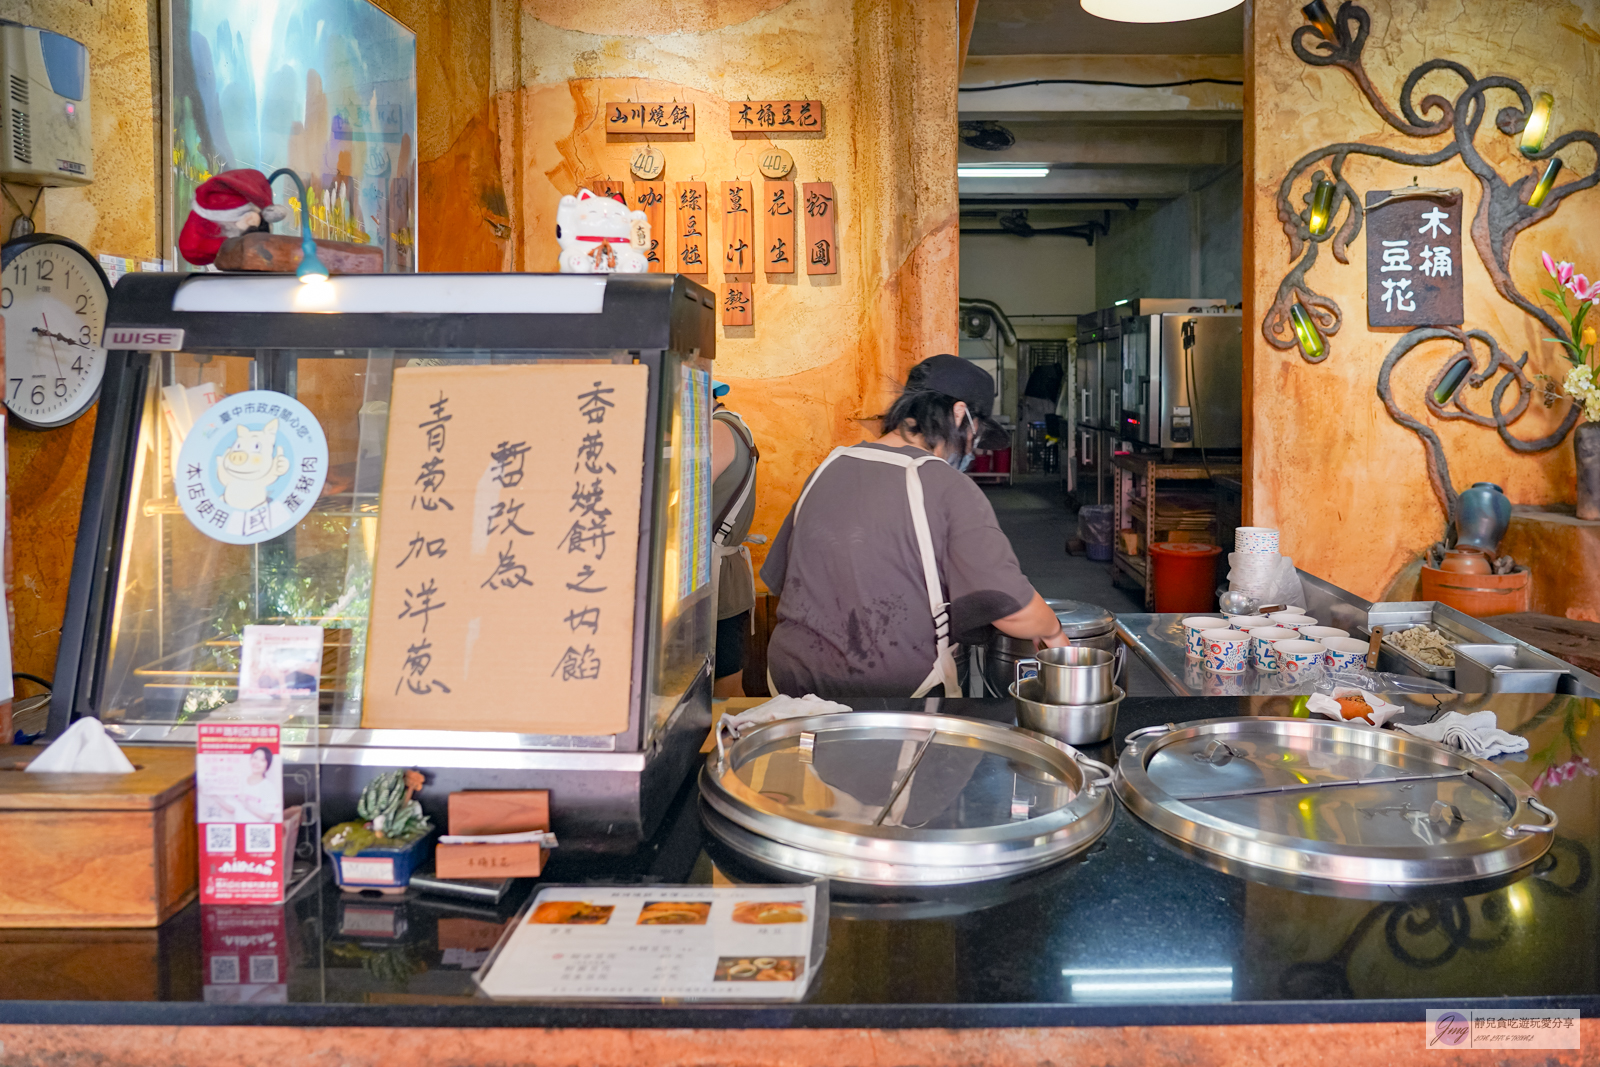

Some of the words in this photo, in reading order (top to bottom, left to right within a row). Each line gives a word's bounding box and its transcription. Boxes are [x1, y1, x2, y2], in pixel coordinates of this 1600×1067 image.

[610, 105, 690, 131] 山川燒餅
[738, 103, 818, 127] 木桶豆花
[762, 154, 789, 174] 40元
[727, 187, 748, 270] 薑汁
[768, 189, 792, 264] 花生
[806, 190, 832, 267] 粉圓
[1418, 206, 1453, 278] 木桶
[14, 264, 27, 286] 11
[37, 259, 54, 281] 12
[65, 270, 70, 290] 1
[1380, 239, 1417, 313] 豆花
[75, 295, 88, 315] 2
[725, 289, 749, 313] 熱
[79, 325, 91, 345] 3
[113, 333, 172, 344] WISE
[71, 355, 83, 376] 4
[10, 378, 23, 400] 7
[31, 385, 45, 405] 6
[54, 377, 67, 398] 5
